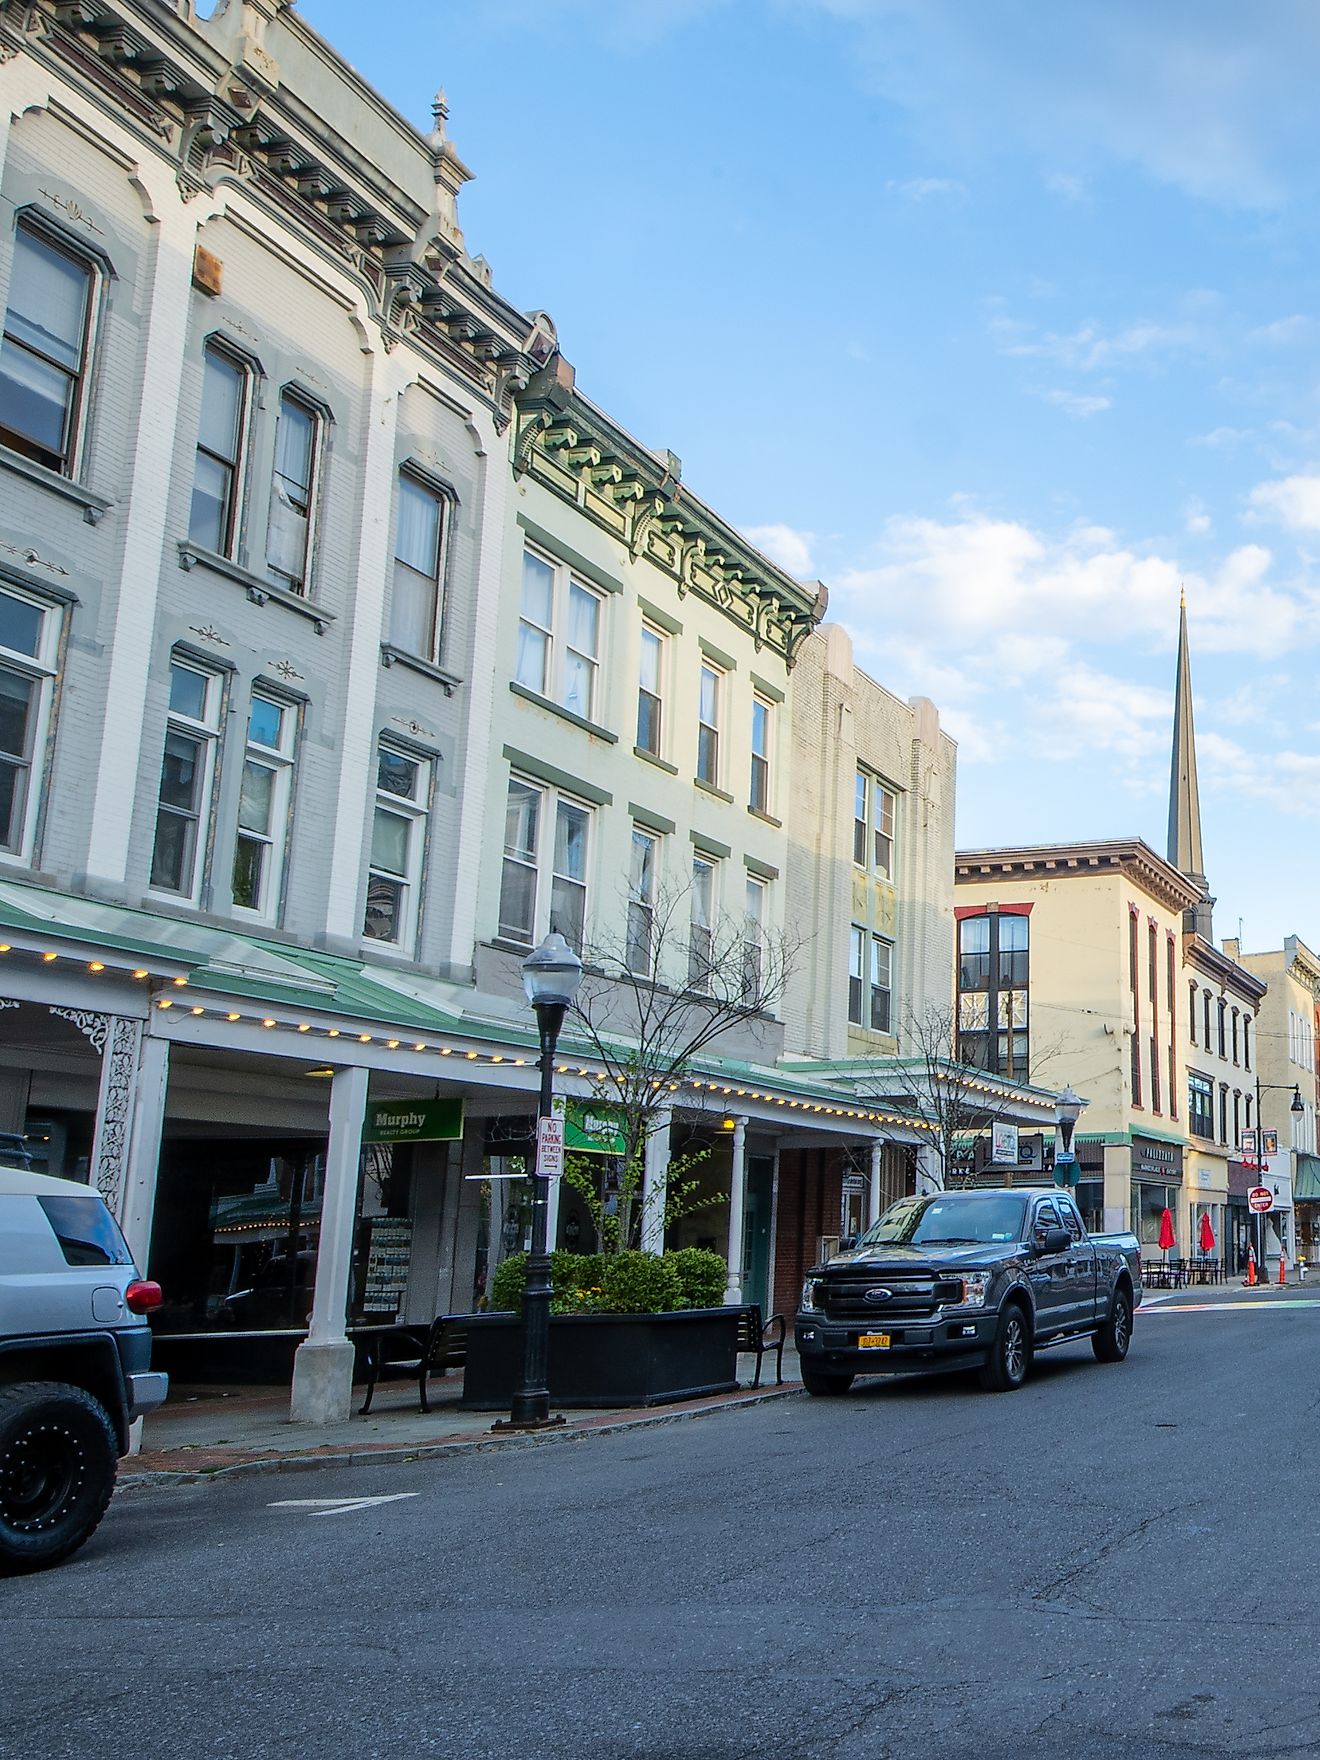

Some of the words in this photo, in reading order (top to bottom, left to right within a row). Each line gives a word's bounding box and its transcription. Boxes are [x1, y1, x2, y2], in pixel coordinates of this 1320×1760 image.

[376, 1112, 426, 1127] Murphy
[547, 1123, 556, 1133] NO
[542, 1134, 561, 1145] PARKING
[541, 1145, 561, 1153] BETWEEN
[544, 1154, 559, 1162] SIGNS
